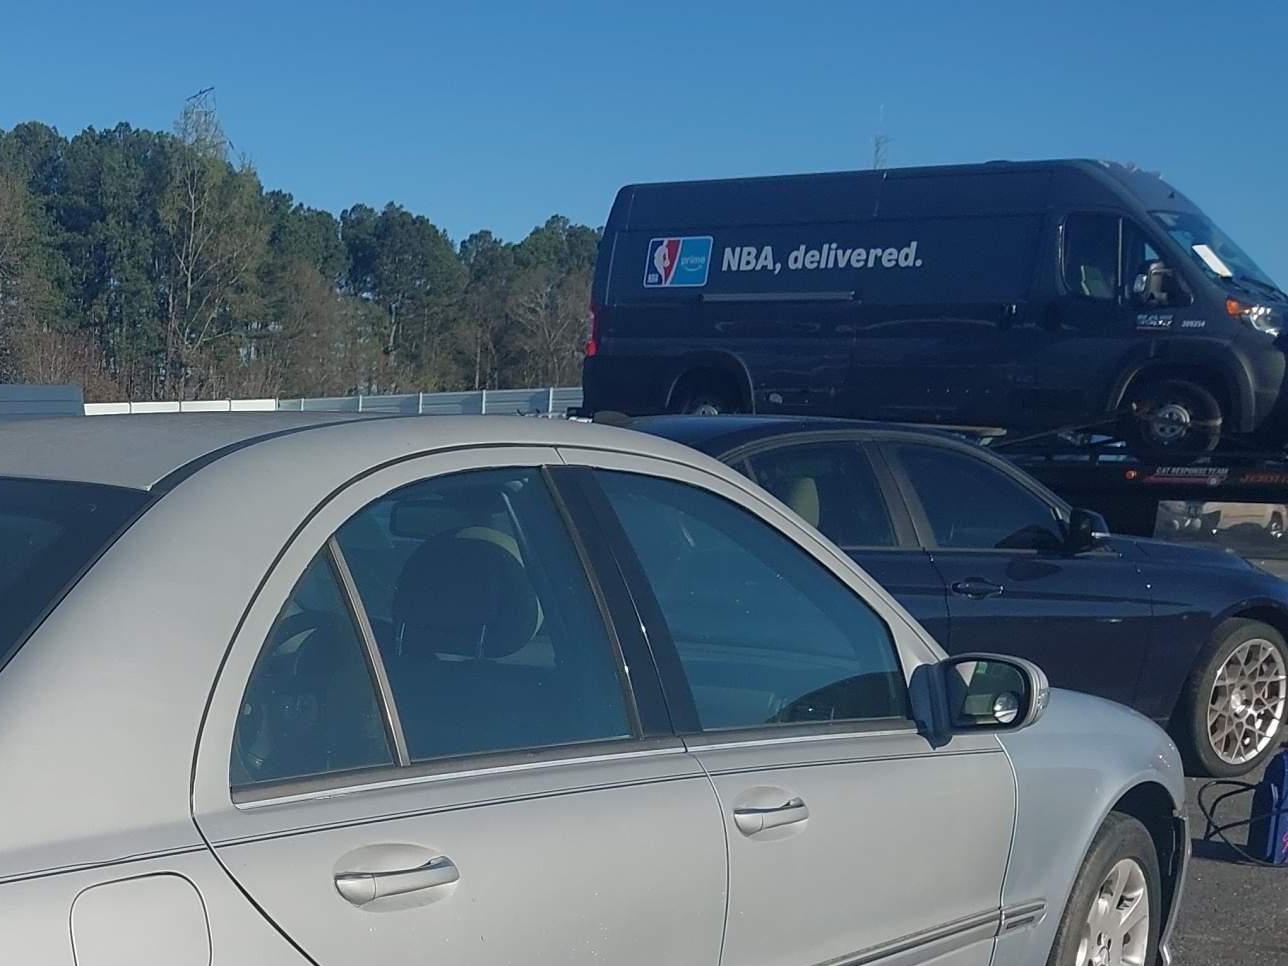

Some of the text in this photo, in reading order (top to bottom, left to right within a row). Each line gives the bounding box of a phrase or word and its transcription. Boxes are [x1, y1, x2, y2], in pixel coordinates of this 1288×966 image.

[681, 256, 706, 266] prime
[721, 241, 923, 275] NBA, delivered.
